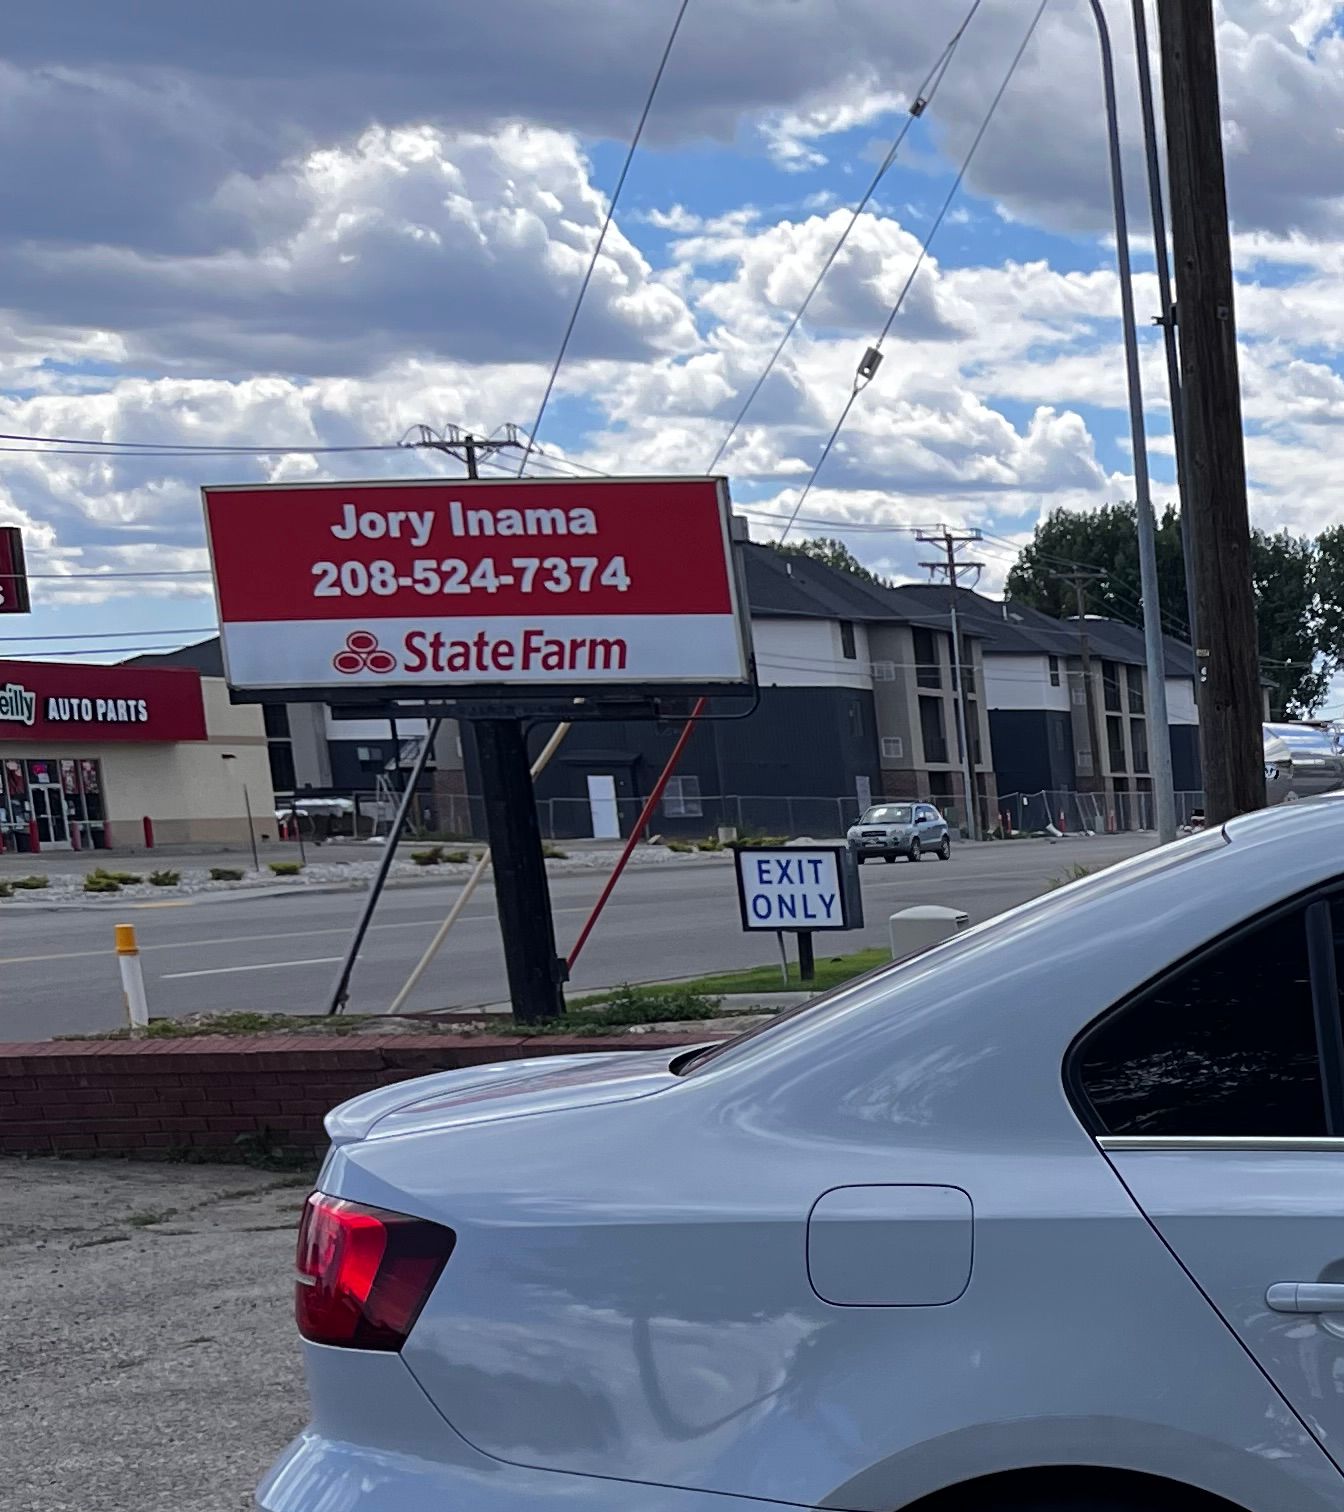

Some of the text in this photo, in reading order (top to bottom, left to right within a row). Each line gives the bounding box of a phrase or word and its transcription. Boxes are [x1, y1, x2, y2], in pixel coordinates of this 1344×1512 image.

[330, 501, 598, 547] Jory Inama
[311, 556, 632, 597] 208-524-7374
[48, 698, 93, 721] AUTO
[96, 699, 149, 722] PARTS
[757, 859, 823, 885] EXIT
[752, 893, 836, 920] ONLY
